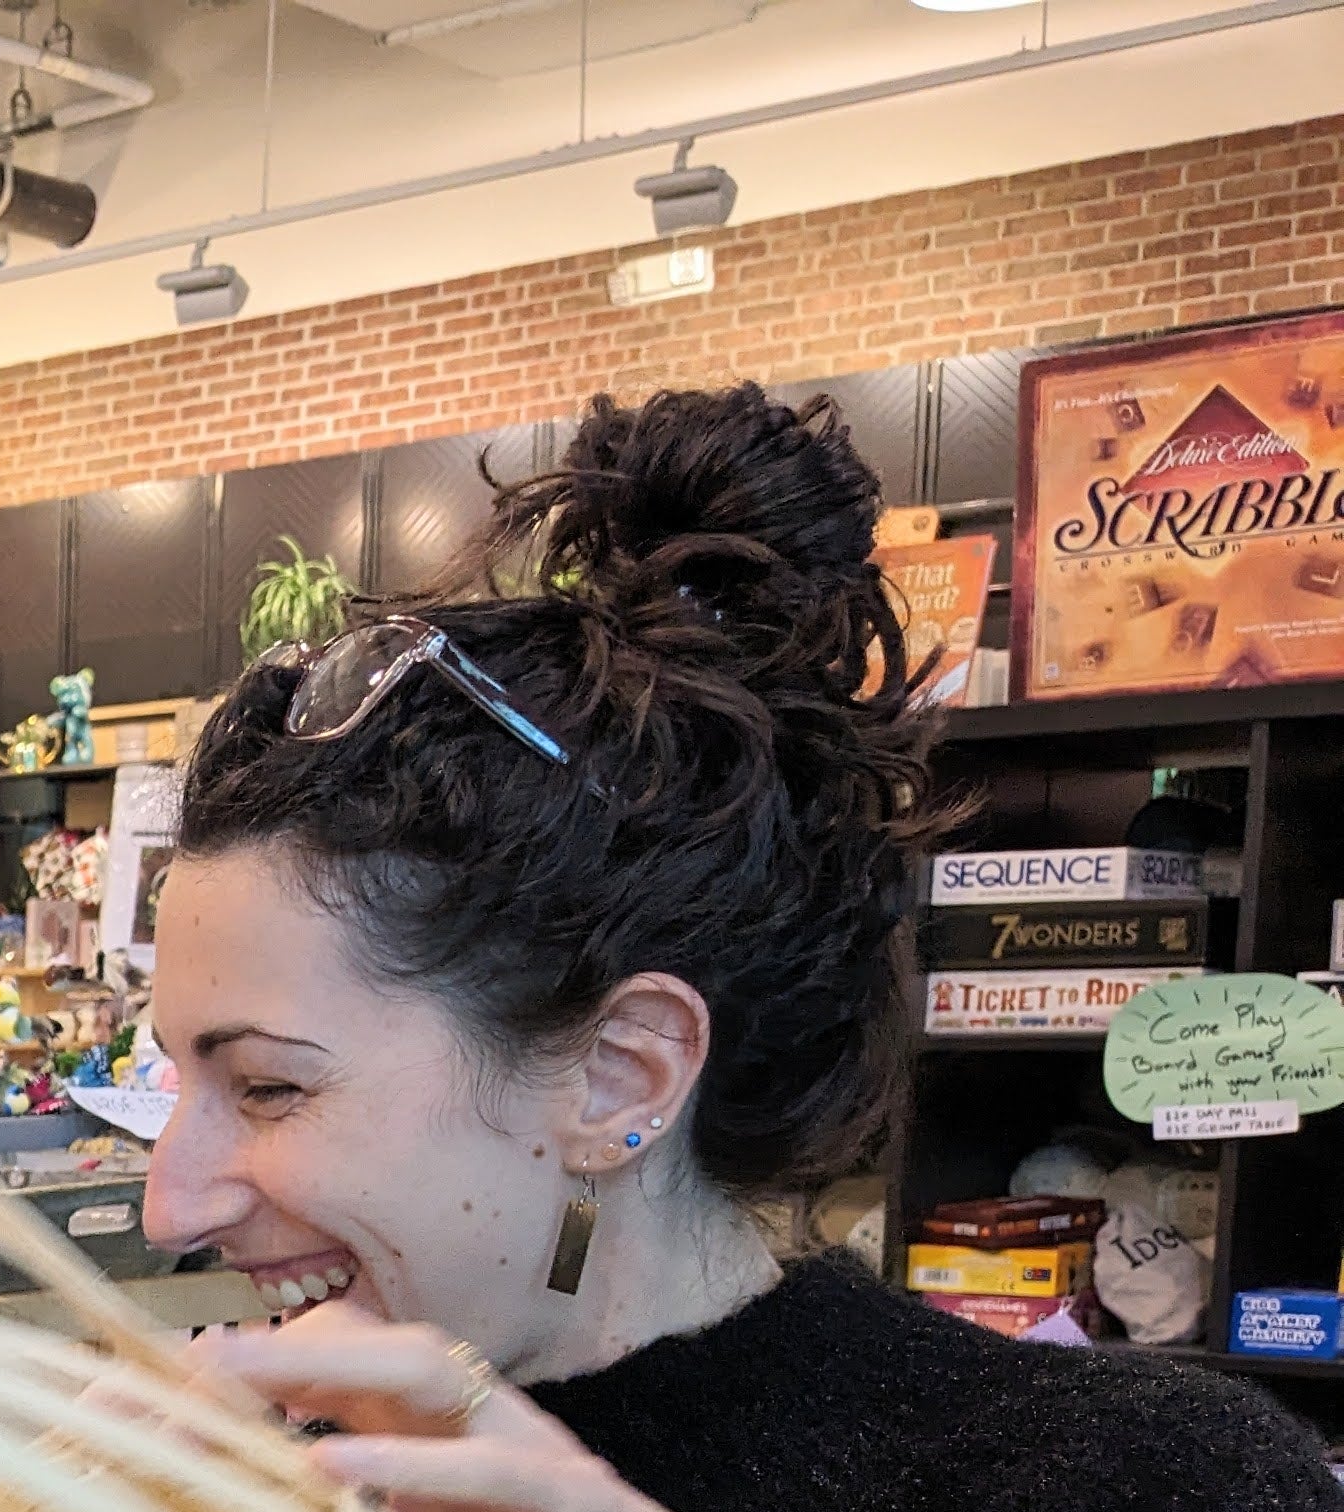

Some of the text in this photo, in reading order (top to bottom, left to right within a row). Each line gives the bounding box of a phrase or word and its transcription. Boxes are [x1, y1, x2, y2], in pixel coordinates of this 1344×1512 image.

[1216, 432, 1300, 463] Edition
[1285, 532, 1344, 548] GAM
[902, 563, 955, 586] That
[943, 855, 1112, 888] SEQUENCE
[1014, 917, 1141, 947] WONDERS
[959, 982, 1051, 1013] TICKET
[1057, 986, 1079, 1006] TO
[1149, 1003, 1287, 1050] Come Play
[1131, 1045, 1277, 1075] Board Games
[1178, 1057, 1333, 1097] with your Friends!
